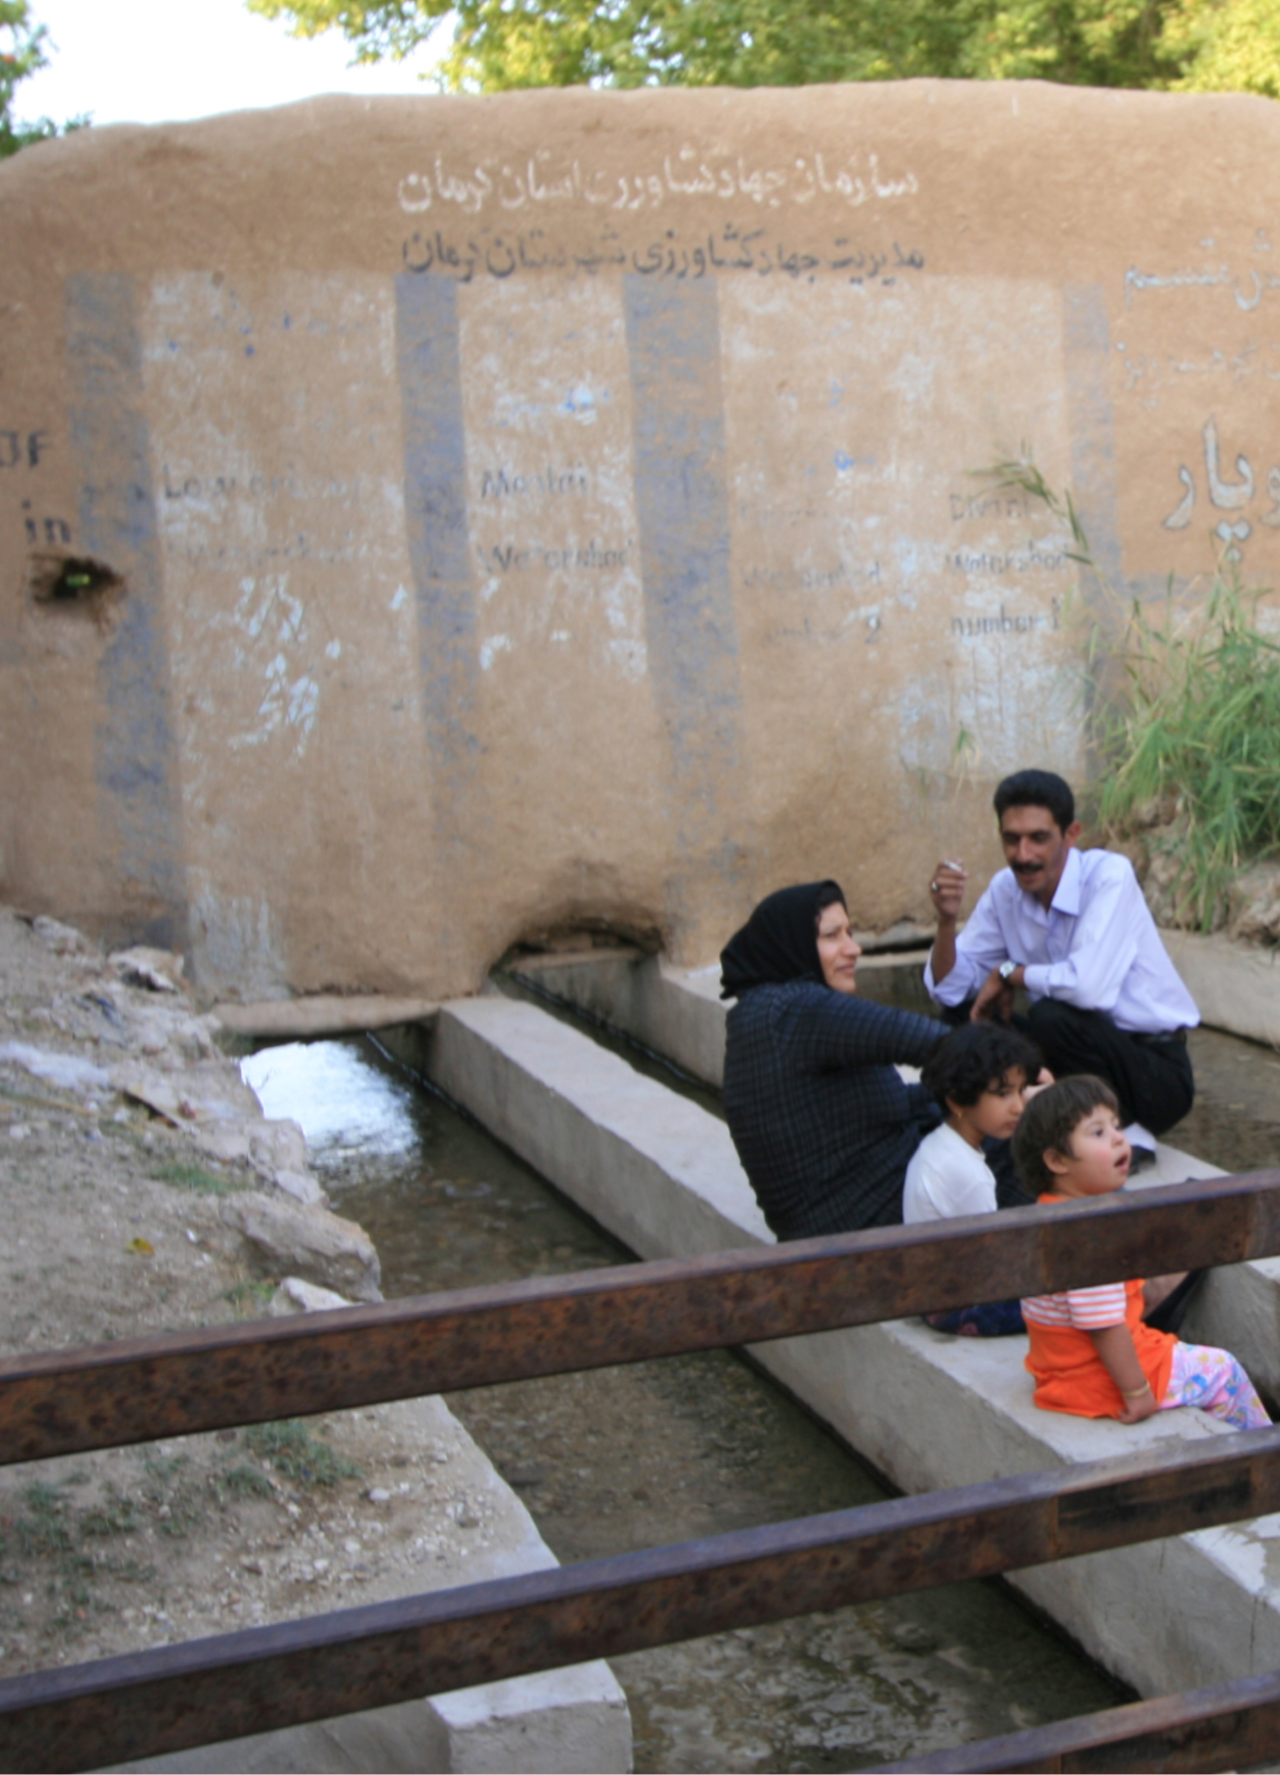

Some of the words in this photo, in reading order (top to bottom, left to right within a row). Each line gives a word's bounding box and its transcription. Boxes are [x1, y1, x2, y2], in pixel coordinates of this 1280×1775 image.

[396, 150, 493, 214] کرمان
[497, 149, 581, 213] استان
[793, 151, 921, 208] سازمان
[630, 219, 768, 281] کشاورزی
[823, 236, 926, 287] مدیریت
